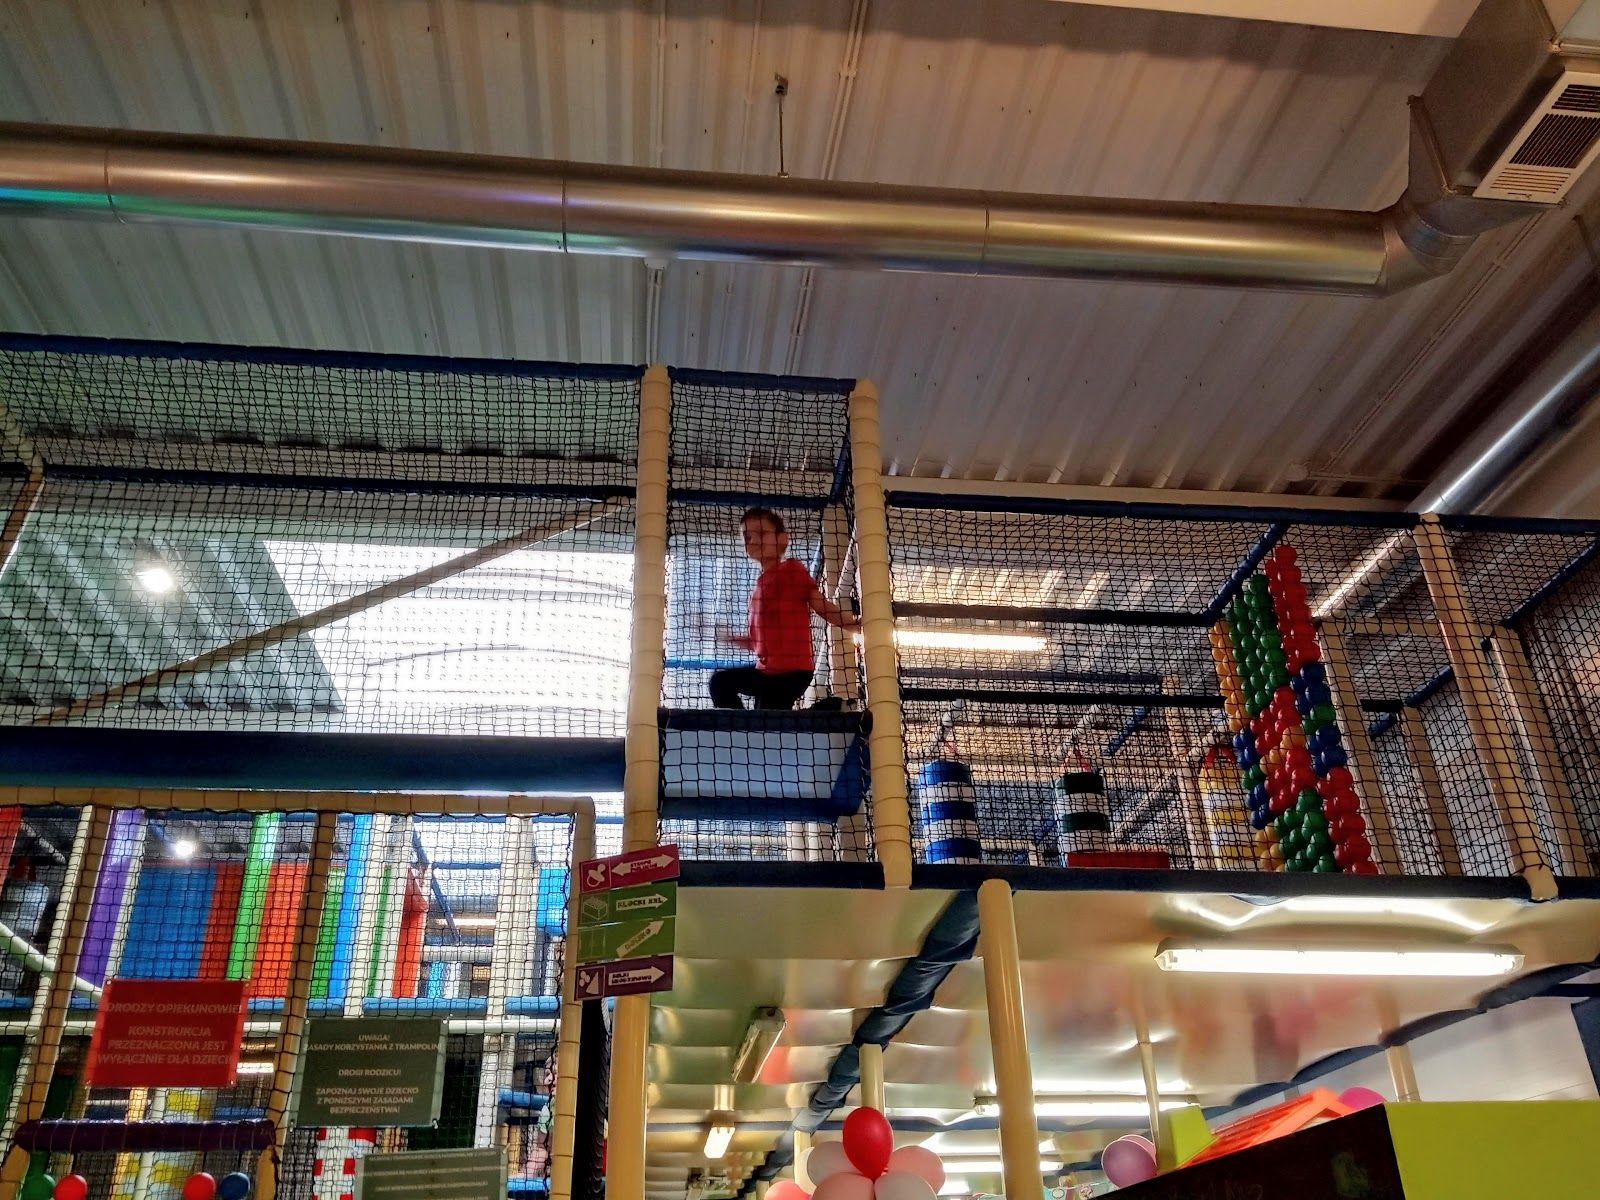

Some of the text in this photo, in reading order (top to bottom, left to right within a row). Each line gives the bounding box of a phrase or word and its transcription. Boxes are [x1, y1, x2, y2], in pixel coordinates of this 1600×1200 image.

[106, 1003, 155, 1014] DRODZY
[128, 1026, 212, 1037] KONSTRUKCJA
[358, 1034, 391, 1042] UWAGA!
[107, 1040, 229, 1051] PRZEZNACZONA JEST
[334, 1043, 387, 1051] KORZYSTANIA
[97, 1054, 166, 1065] WYŁĄCZNIE
[167, 1054, 190, 1065] DLA
[338, 1069, 363, 1077] DROGI
[316, 1086, 419, 1096] ZAPOZNAJ SWOJE DZIECKO
[373, 1096, 414, 1104] ZASADAMI
